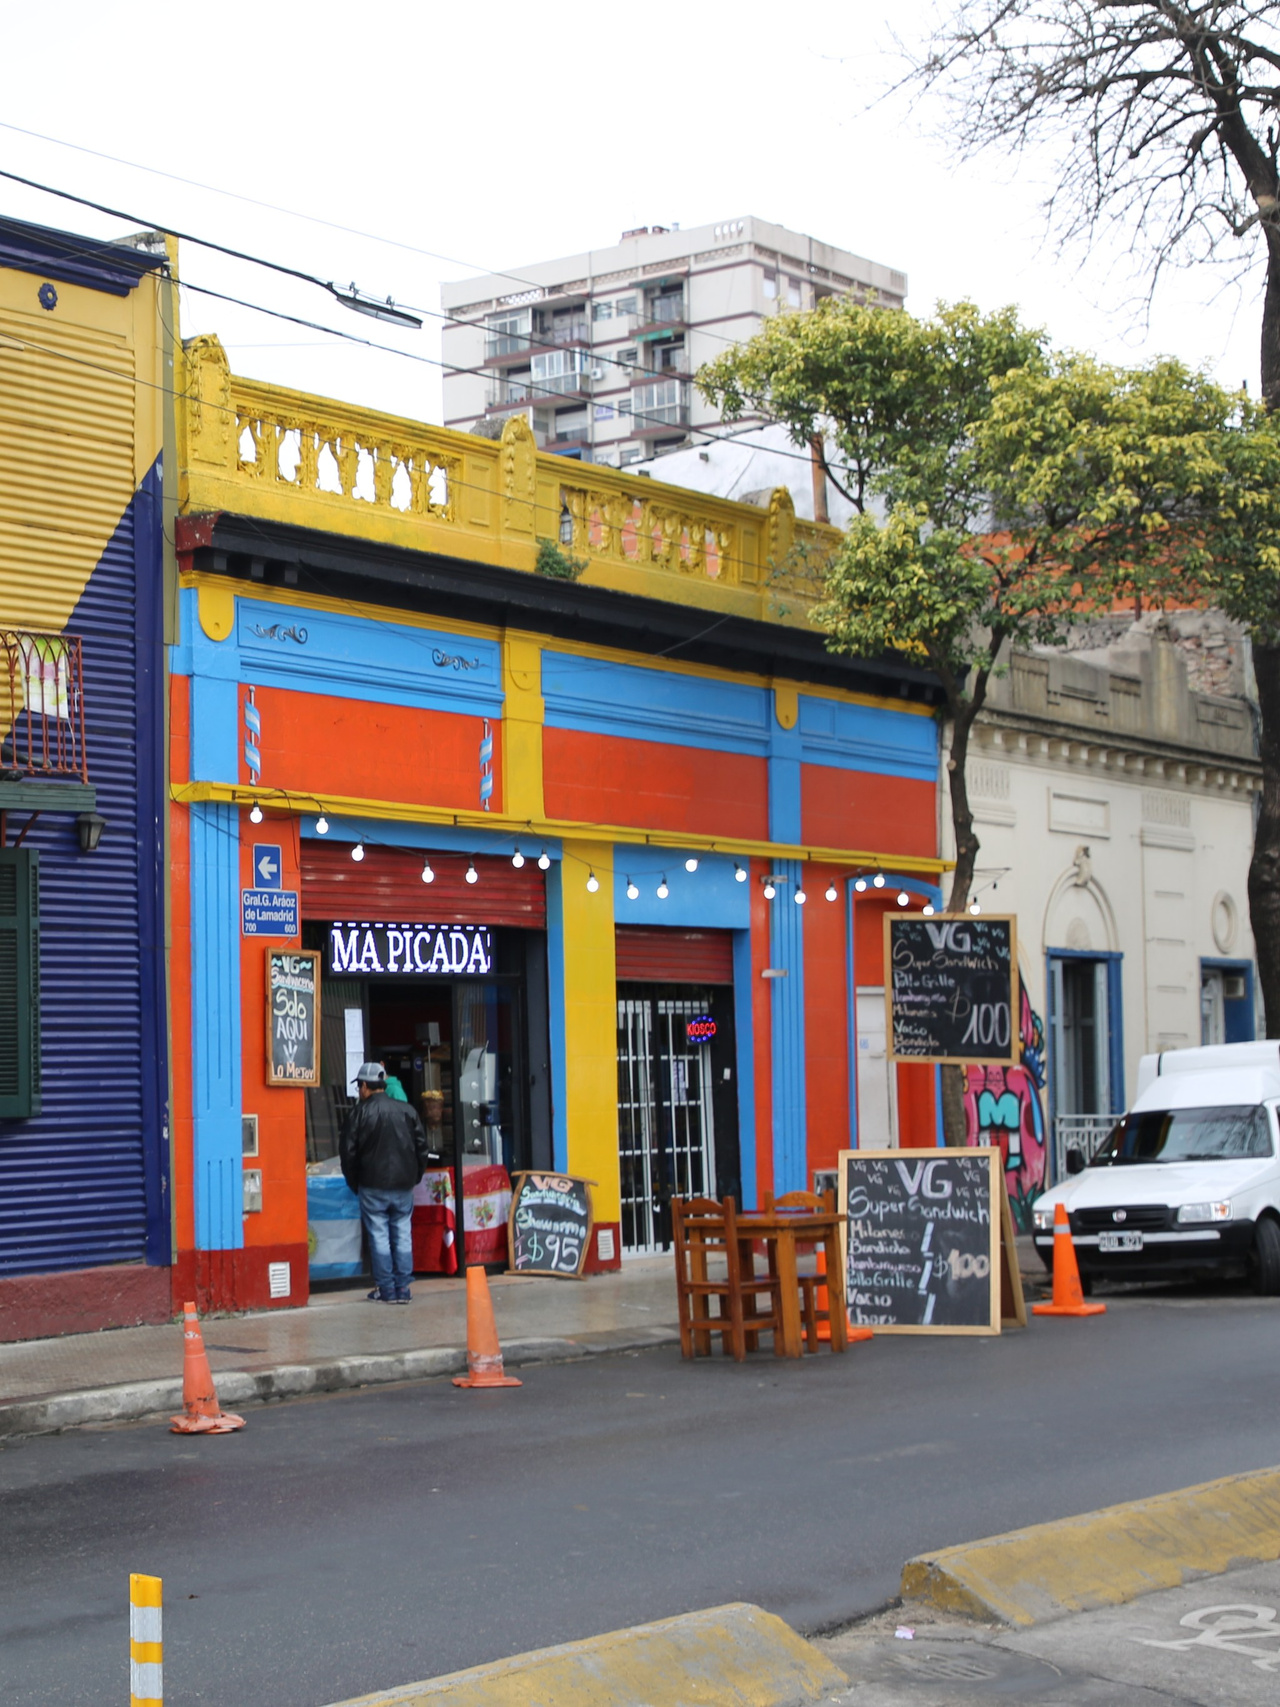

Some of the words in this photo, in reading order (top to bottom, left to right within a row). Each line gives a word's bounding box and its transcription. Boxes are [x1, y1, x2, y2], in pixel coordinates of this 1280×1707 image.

[272, 895, 295, 908] Aráoz
[245, 908, 256, 920] de
[257, 909, 293, 922] Lamadrid
[245, 922, 257, 932] 700
[284, 924, 296, 933] 600
[925, 922, 971, 953] VG
[331, 929, 382, 970] MA
[386, 931, 488, 972] PICADA
[281, 956, 300, 974] VG
[273, 988, 307, 1020] Solo
[276, 1016, 308, 1042] AQUI
[686, 1022, 717, 1036] KIOSCO
[531, 1175, 574, 1193] VG
[894, 1159, 953, 1199] VG
[848, 1185, 906, 1222] Super
[907, 1195, 990, 1224] Sandwich
